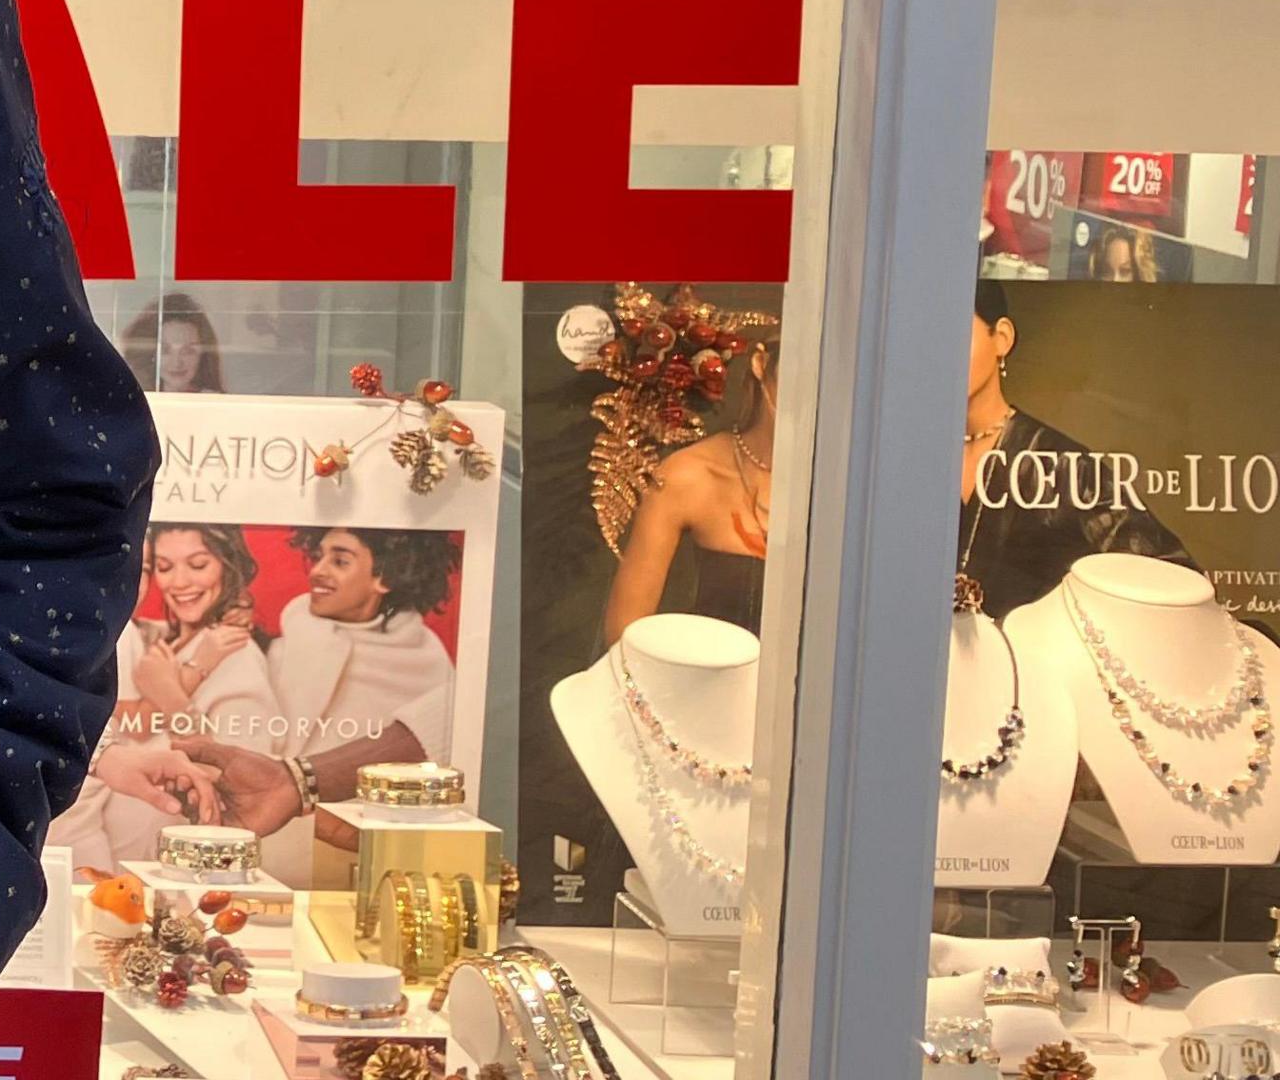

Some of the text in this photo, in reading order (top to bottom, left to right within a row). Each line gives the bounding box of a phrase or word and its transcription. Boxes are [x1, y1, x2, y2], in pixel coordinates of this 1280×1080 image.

[1006, 150, 1066, 219] 20%
[1108, 153, 1163, 196] 20%
[1144, 182, 1162, 196] OFF
[1146, 468, 1181, 496] DE
